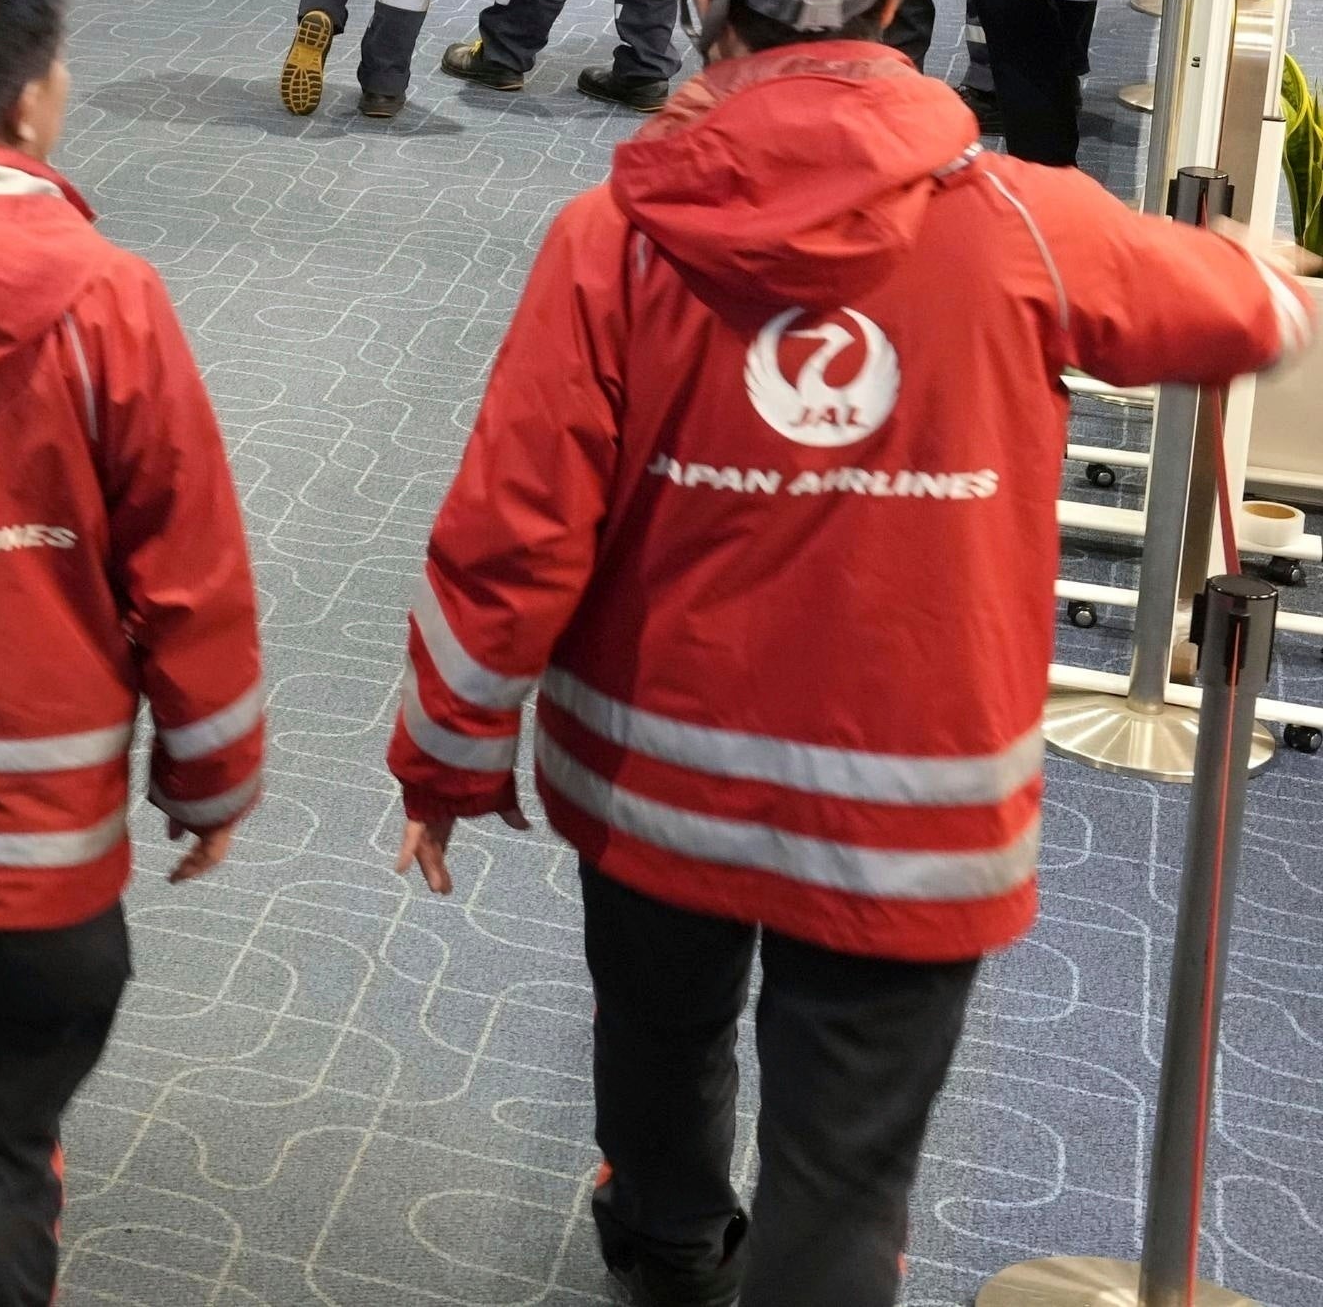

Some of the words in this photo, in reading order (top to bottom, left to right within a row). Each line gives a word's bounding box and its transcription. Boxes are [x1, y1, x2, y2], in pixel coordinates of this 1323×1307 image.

[789, 405, 874, 431] JAL
[648, 452, 783, 495] JAPAN
[786, 467, 1000, 500] AIRLINES
